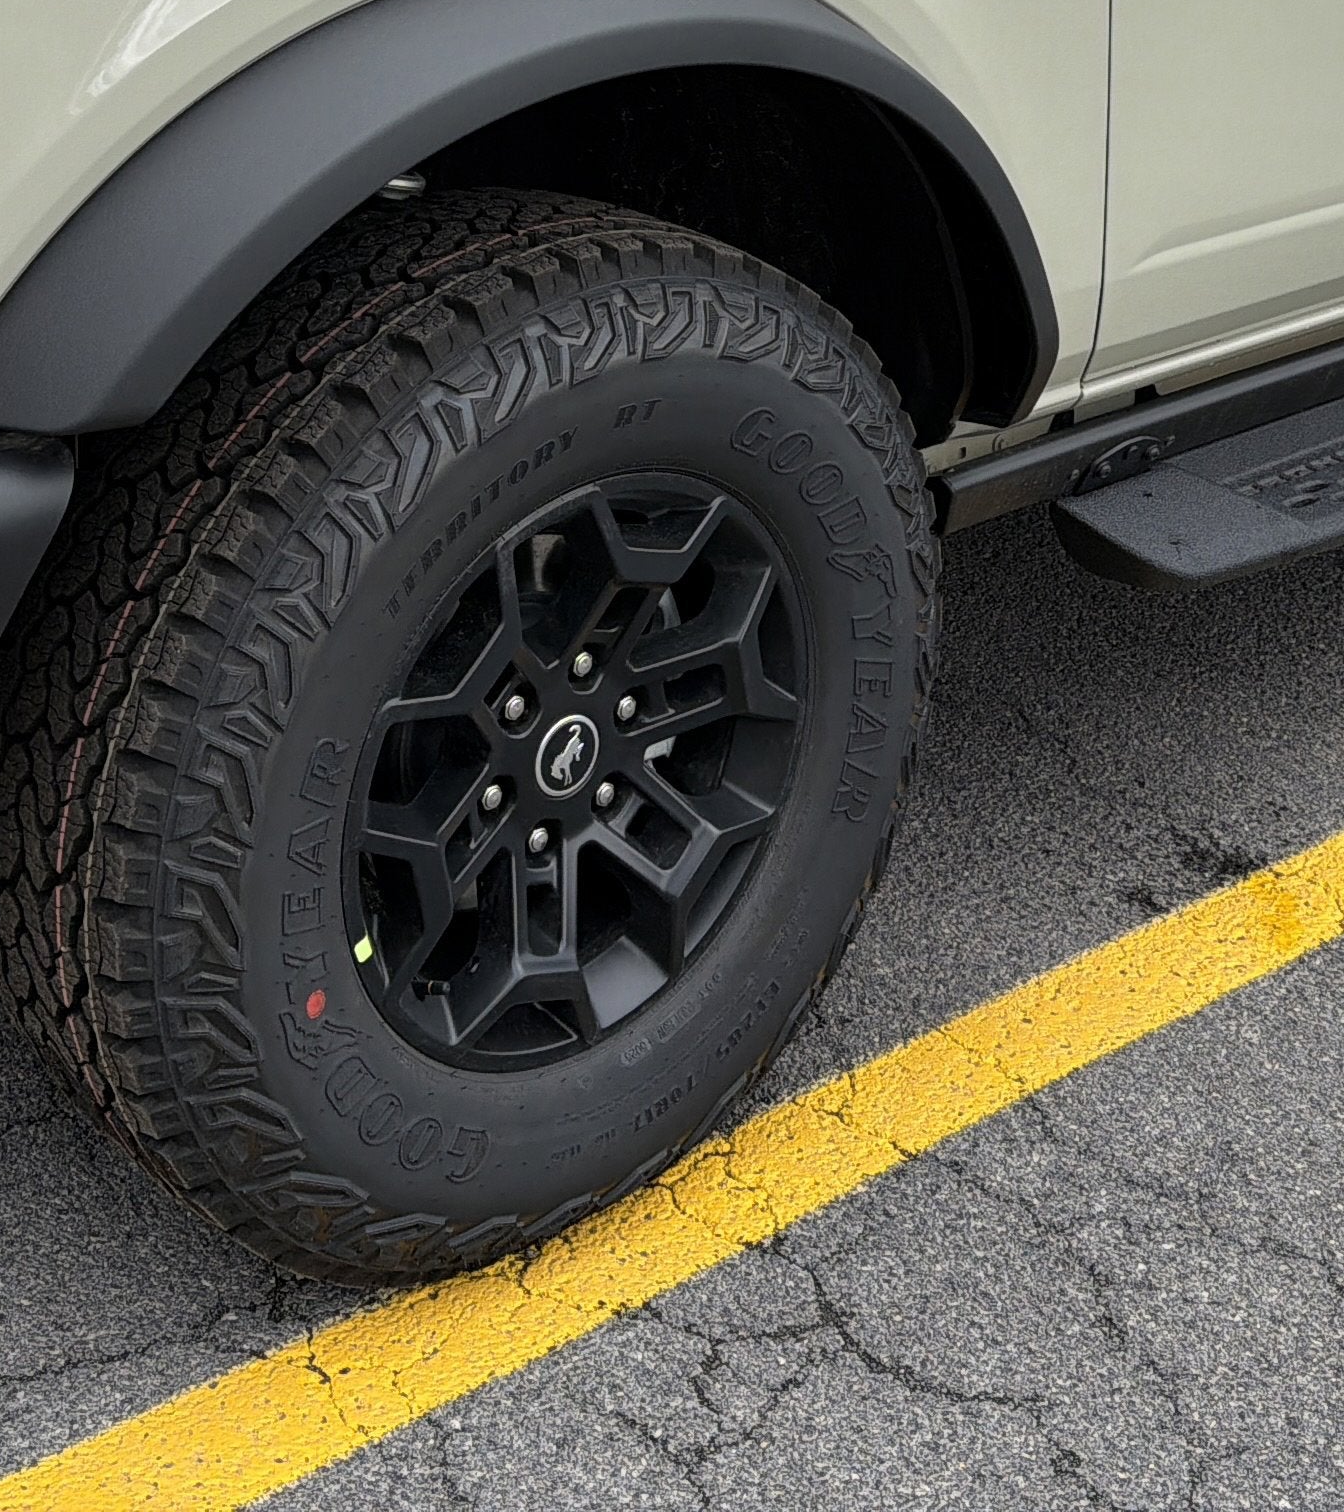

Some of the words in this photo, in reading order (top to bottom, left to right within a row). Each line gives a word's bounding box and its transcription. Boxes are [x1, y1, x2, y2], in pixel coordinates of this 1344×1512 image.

[382, 425, 579, 620] TERRITORY
[612, 397, 663, 430] RT
[729, 406, 897, 824] GOODYEAR
[278, 737, 491, 1184] GOODYEAR
